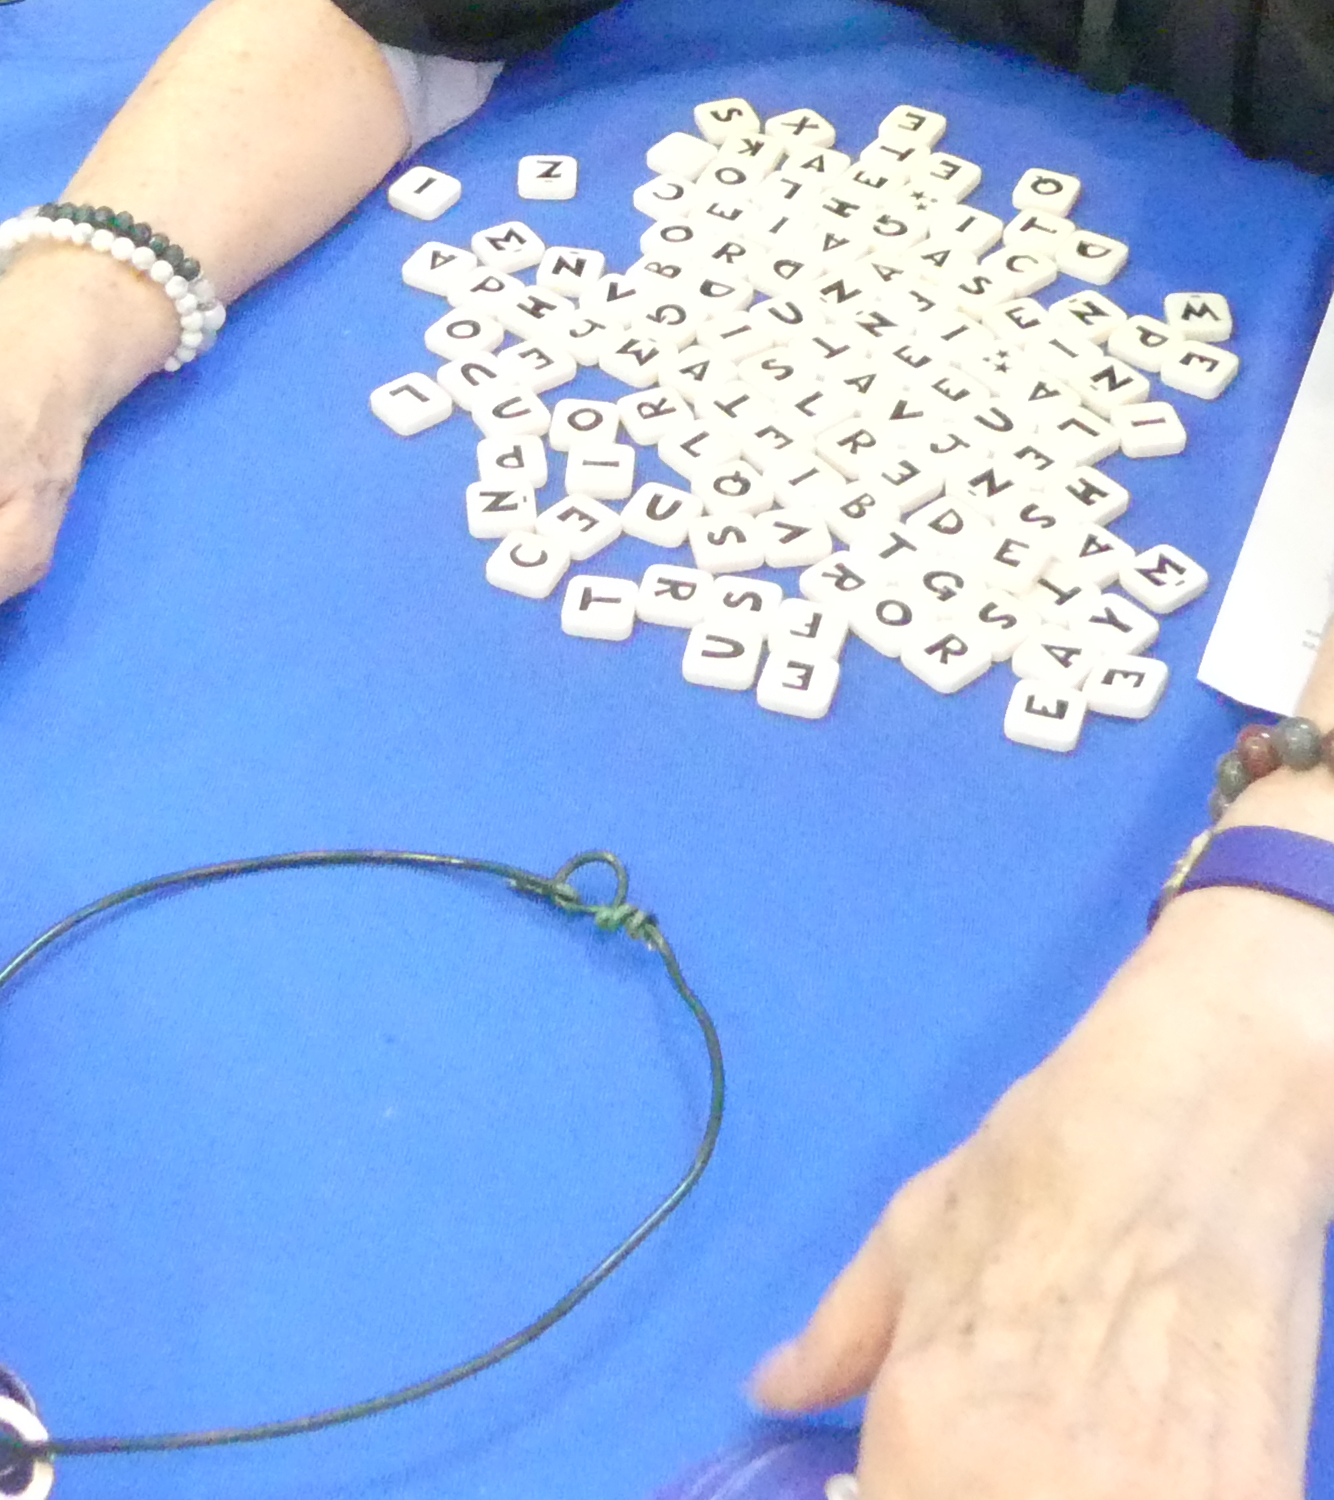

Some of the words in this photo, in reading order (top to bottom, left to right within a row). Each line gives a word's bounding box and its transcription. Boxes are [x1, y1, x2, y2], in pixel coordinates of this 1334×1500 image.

[710, 108, 743, 122] S
[782, 116, 819, 135] X
[899, 112, 926, 131] E
[738, 139, 764, 156] K
[880, 146, 915, 161] T
[800, 155, 824, 172] A
[930, 160, 961, 180] E
[715, 167, 746, 185] O
[853, 171, 888, 188] E
[653, 184, 684, 200] C
[781, 178, 802, 199] L
[706, 203, 743, 221] E
[822, 198, 860, 218] H
[660, 226, 693, 242] O
[873, 214, 908, 236] G
[1020, 217, 1057, 234] T
[712, 242, 746, 263] R
[823, 233, 849, 251] A
[431, 251, 457, 270] A
[774, 260, 804, 279] D
[921, 250, 950, 267] A
[1006, 255, 1038, 272] C
[645, 262, 681, 278] B
[872, 264, 903, 282] A
[470, 276, 505, 292] P
[607, 282, 636, 302] V
[958, 276, 992, 295] S
[517, 296, 557, 319] H
[646, 304, 686, 325] G
[768, 302, 803, 324] U
[1005, 307, 1041, 329] E
[446, 320, 481, 339] O
[570, 319, 606, 338] J
[1136, 326, 1168, 347] P
[518, 348, 554, 369] E
[812, 337, 850, 359] T
[893, 346, 932, 368] E
[679, 360, 710, 381] A
[761, 359, 794, 381] S
[1179, 352, 1219, 372] E
[461, 363, 497, 386] U
[844, 374, 876, 394] A
[389, 385, 430, 402] L
[931, 378, 970, 401] E
[1028, 381, 1060, 401] A
[492, 397, 531, 418] U
[637, 398, 676, 419] R
[714, 394, 749, 418] T
[795, 391, 823, 417] L
[889, 400, 923, 420] V
[567, 408, 603, 431] O
[974, 407, 1013, 432] U
[1057, 418, 1100, 437] L
[680, 432, 709, 457] L
[755, 426, 793, 449] E
[837, 429, 876, 454] R
[930, 434, 970, 453] J
[496, 445, 524, 468] P
[1014, 446, 1054, 470] E
[713, 471, 751, 496] Q
[882, 460, 921, 486] E
[1066, 478, 1109, 506] H
[646, 494, 682, 520] U
[840, 493, 875, 519] B
[1020, 503, 1056, 528] S
[557, 506, 599, 532] E
[928, 509, 963, 534] D
[707, 526, 746, 545] S
[773, 522, 811, 544] V
[510, 544, 548, 567] C
[879, 532, 917, 559] T
[994, 539, 1029, 567] E
[1079, 534, 1114, 557] A
[822, 563, 865, 591] R
[923, 571, 964, 601] G
[579, 587, 622, 611] T
[655, 577, 696, 600] R
[1037, 577, 1081, 605] T
[723, 592, 762, 611] S
[876, 600, 912, 626] O
[979, 602, 1017, 629] S
[1089, 607, 1133, 633] Y
[790, 613, 822, 638] F
[701, 635, 745, 658] U
[924, 634, 968, 664] R
[1042, 644, 1082, 668] A
[782, 661, 814, 690] E
[1101, 669, 1145, 687] E
[1025, 695, 1068, 719] E
